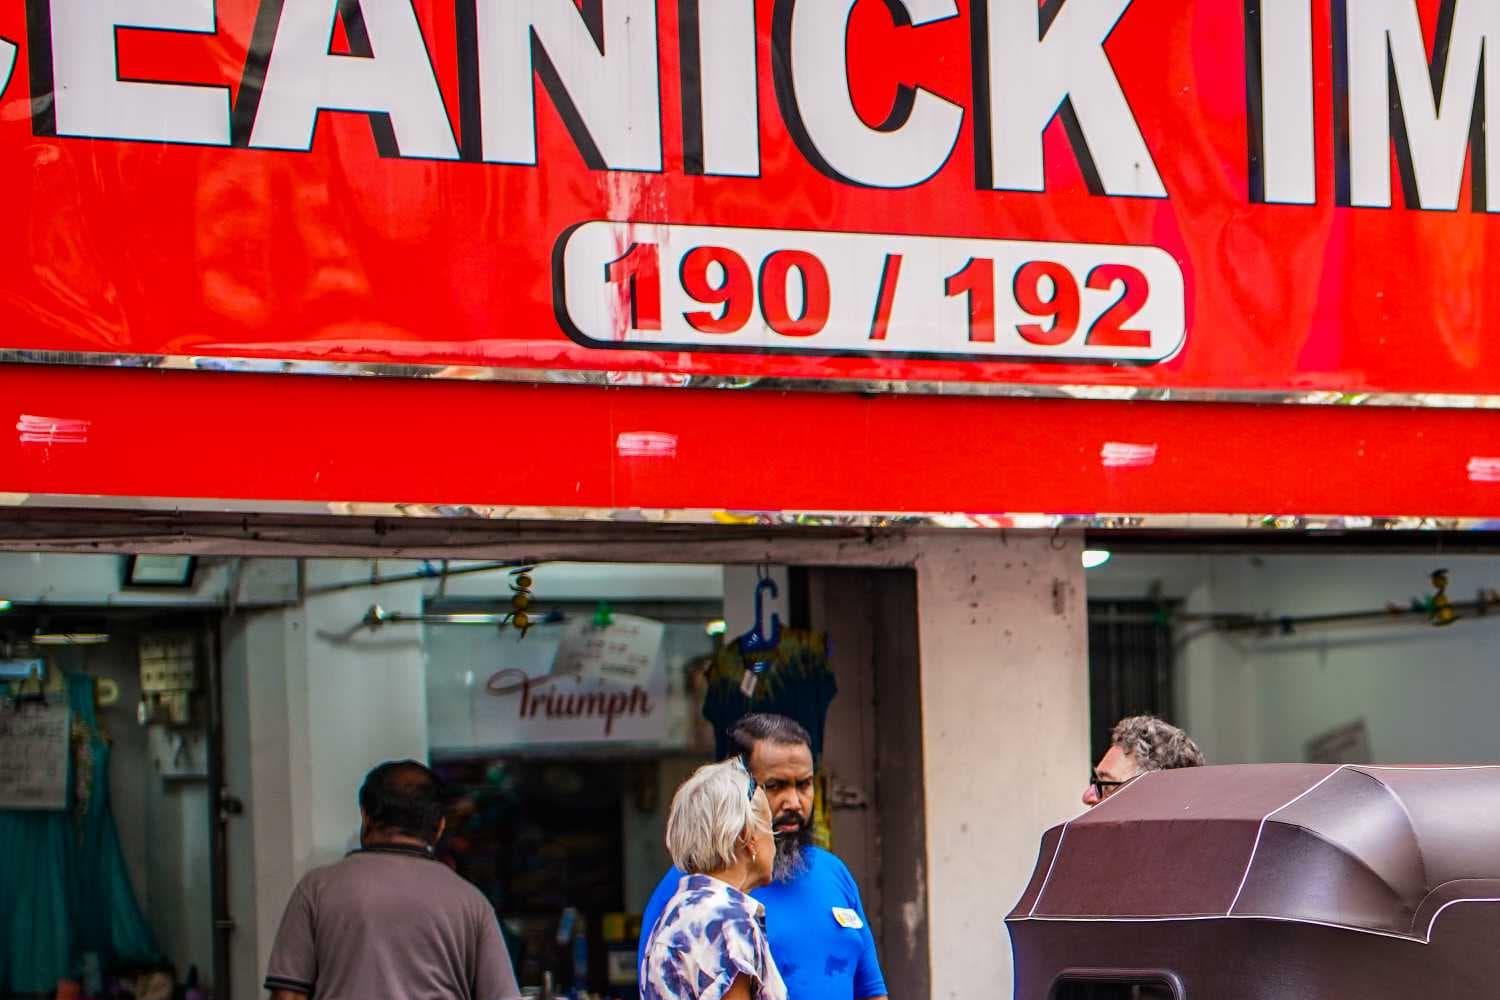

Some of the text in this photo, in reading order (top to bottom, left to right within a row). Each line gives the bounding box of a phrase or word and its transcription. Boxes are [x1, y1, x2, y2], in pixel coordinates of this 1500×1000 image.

[0, 0, 1168, 198] EANICK
[604, 242, 831, 338] 190
[944, 256, 1152, 349] 192
[487, 667, 656, 737] Triumph
